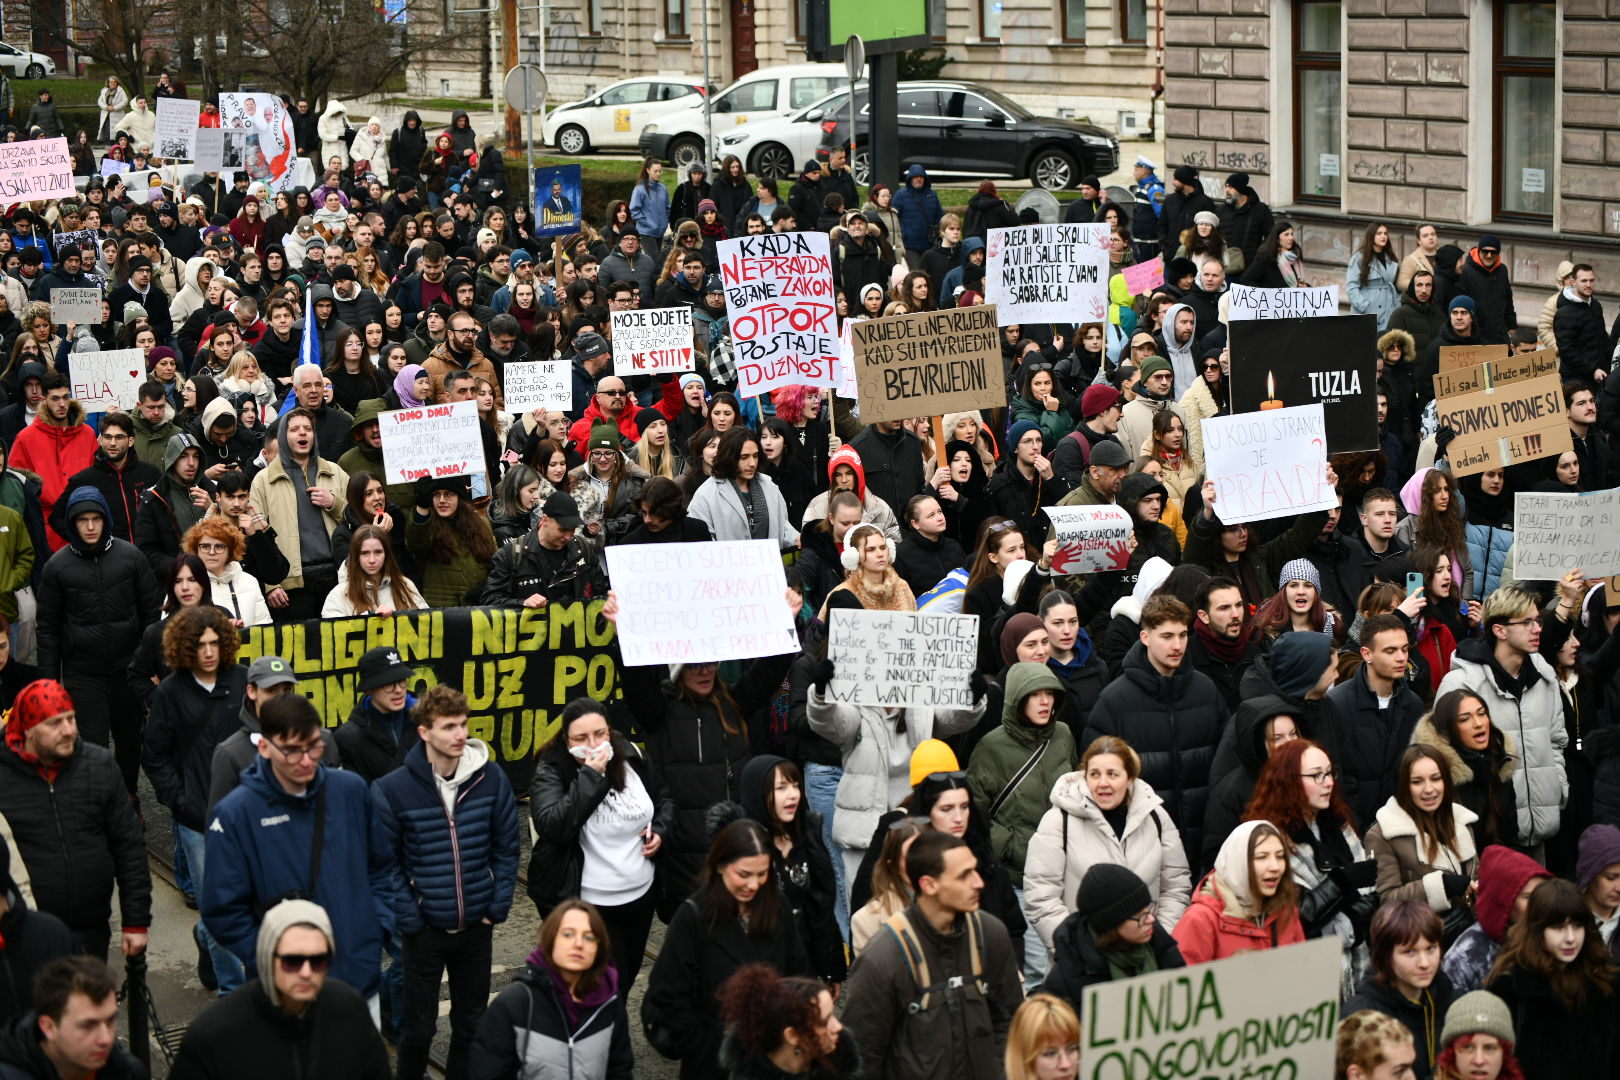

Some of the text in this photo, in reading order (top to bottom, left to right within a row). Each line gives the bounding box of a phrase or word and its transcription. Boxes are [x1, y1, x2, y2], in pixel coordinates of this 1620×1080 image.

[11, 158, 37, 168] SAMO
[32, 176, 46, 192] PO
[740, 234, 812, 258] KADA
[1004, 229, 1027, 248] DJECA
[1046, 226, 1053, 244] U
[1003, 250, 1010, 267] A
[1012, 248, 1021, 265] VI
[1024, 246, 1032, 264] IH
[722, 253, 832, 287] NEPRAVDA
[1003, 267, 1016, 287] NA
[1068, 265, 1098, 283] ZVANO
[726, 276, 833, 309] POSTANE ZAKON
[1232, 287, 1333, 309] VAŠA ŠUTNJA
[614, 310, 690, 328] MOJE DIJETE
[733, 302, 834, 340] OTPOR
[855, 320, 916, 345] VRIJEDE
[614, 341, 620, 351] A
[624, 341, 636, 350] NE
[736, 332, 832, 360] POSTAJE
[864, 345, 894, 366] KAD
[897, 342, 916, 361] SU
[544, 364, 556, 374] NE
[632, 353, 646, 370] NE
[738, 353, 839, 385] DUŽNOST
[532, 376, 546, 384] OD
[884, 358, 987, 400] BEZVRIJEDNI
[1308, 370, 1362, 398] TUZLA
[1459, 370, 1478, 392] sad
[1493, 364, 1518, 382] druže
[1519, 364, 1531, 378] moj
[1532, 356, 1556, 377] ljubavi
[74, 382, 114, 400] ELLA
[556, 382, 564, 390] A
[505, 395, 530, 404] VLADA
[532, 394, 544, 402] OD
[1441, 404, 1499, 436] OSTAVKU
[1206, 426, 1220, 451] U
[1225, 422, 1267, 448] KOJOJ
[1251, 448, 1268, 468] JE
[1456, 446, 1490, 468] odmah
[1510, 441, 1522, 458] ti
[1218, 461, 1329, 516] PRAVDA
[1520, 498, 1548, 510] STARI
[1580, 516, 1594, 528] DA
[1600, 514, 1612, 525] BI
[1518, 530, 1596, 546] REKLAMIRALI
[711, 604, 770, 628] STATI
[832, 611, 860, 630] We
[872, 614, 894, 630] want
[236, 599, 616, 674] HULIGANI NISMO
[898, 638, 916, 650] THE
[463, 656, 526, 711] UZ
[827, 680, 863, 703] WE
[876, 684, 921, 704] WANT
[1090, 969, 1223, 1048] LINIJA
